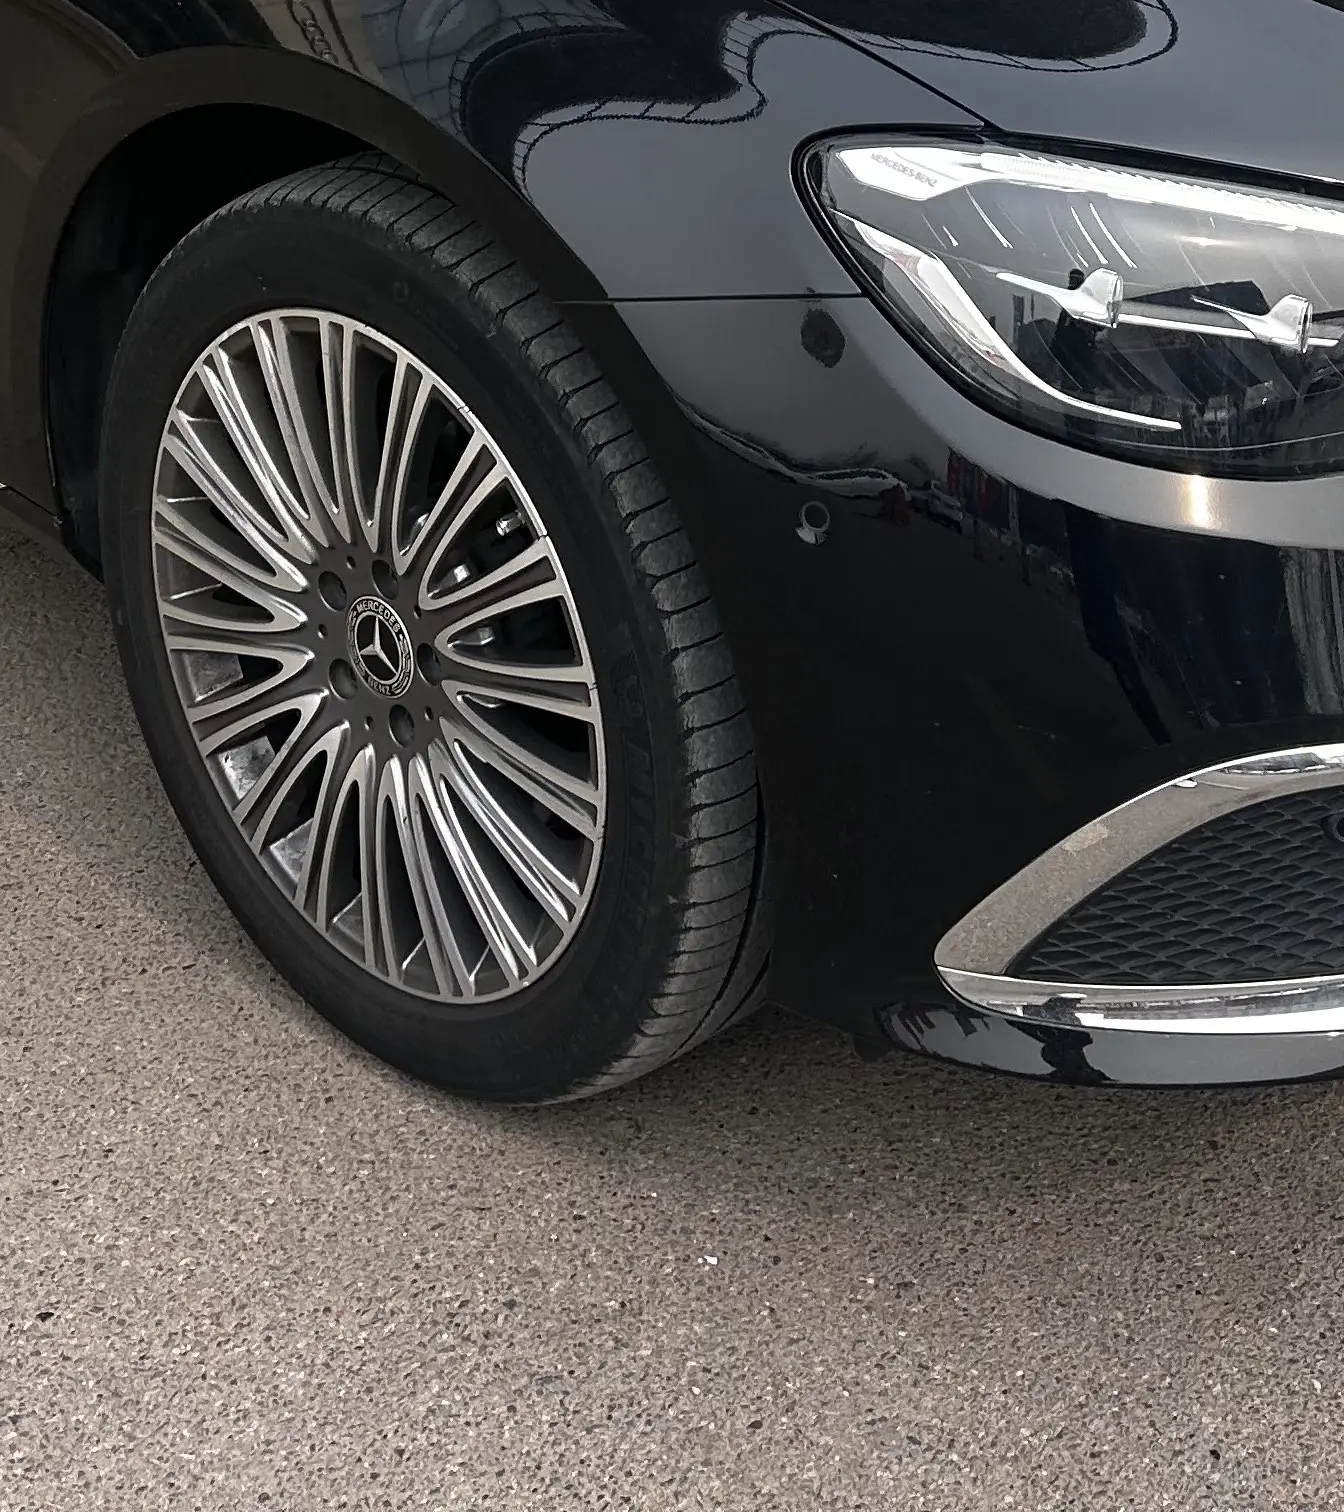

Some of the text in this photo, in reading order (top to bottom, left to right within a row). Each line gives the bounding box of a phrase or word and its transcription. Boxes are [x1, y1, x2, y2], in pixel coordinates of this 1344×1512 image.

[870, 152, 938, 188] MERCEDES-BENZ
[355, 599, 402, 634] MERCEDES
[367, 676, 392, 696] BENZ
